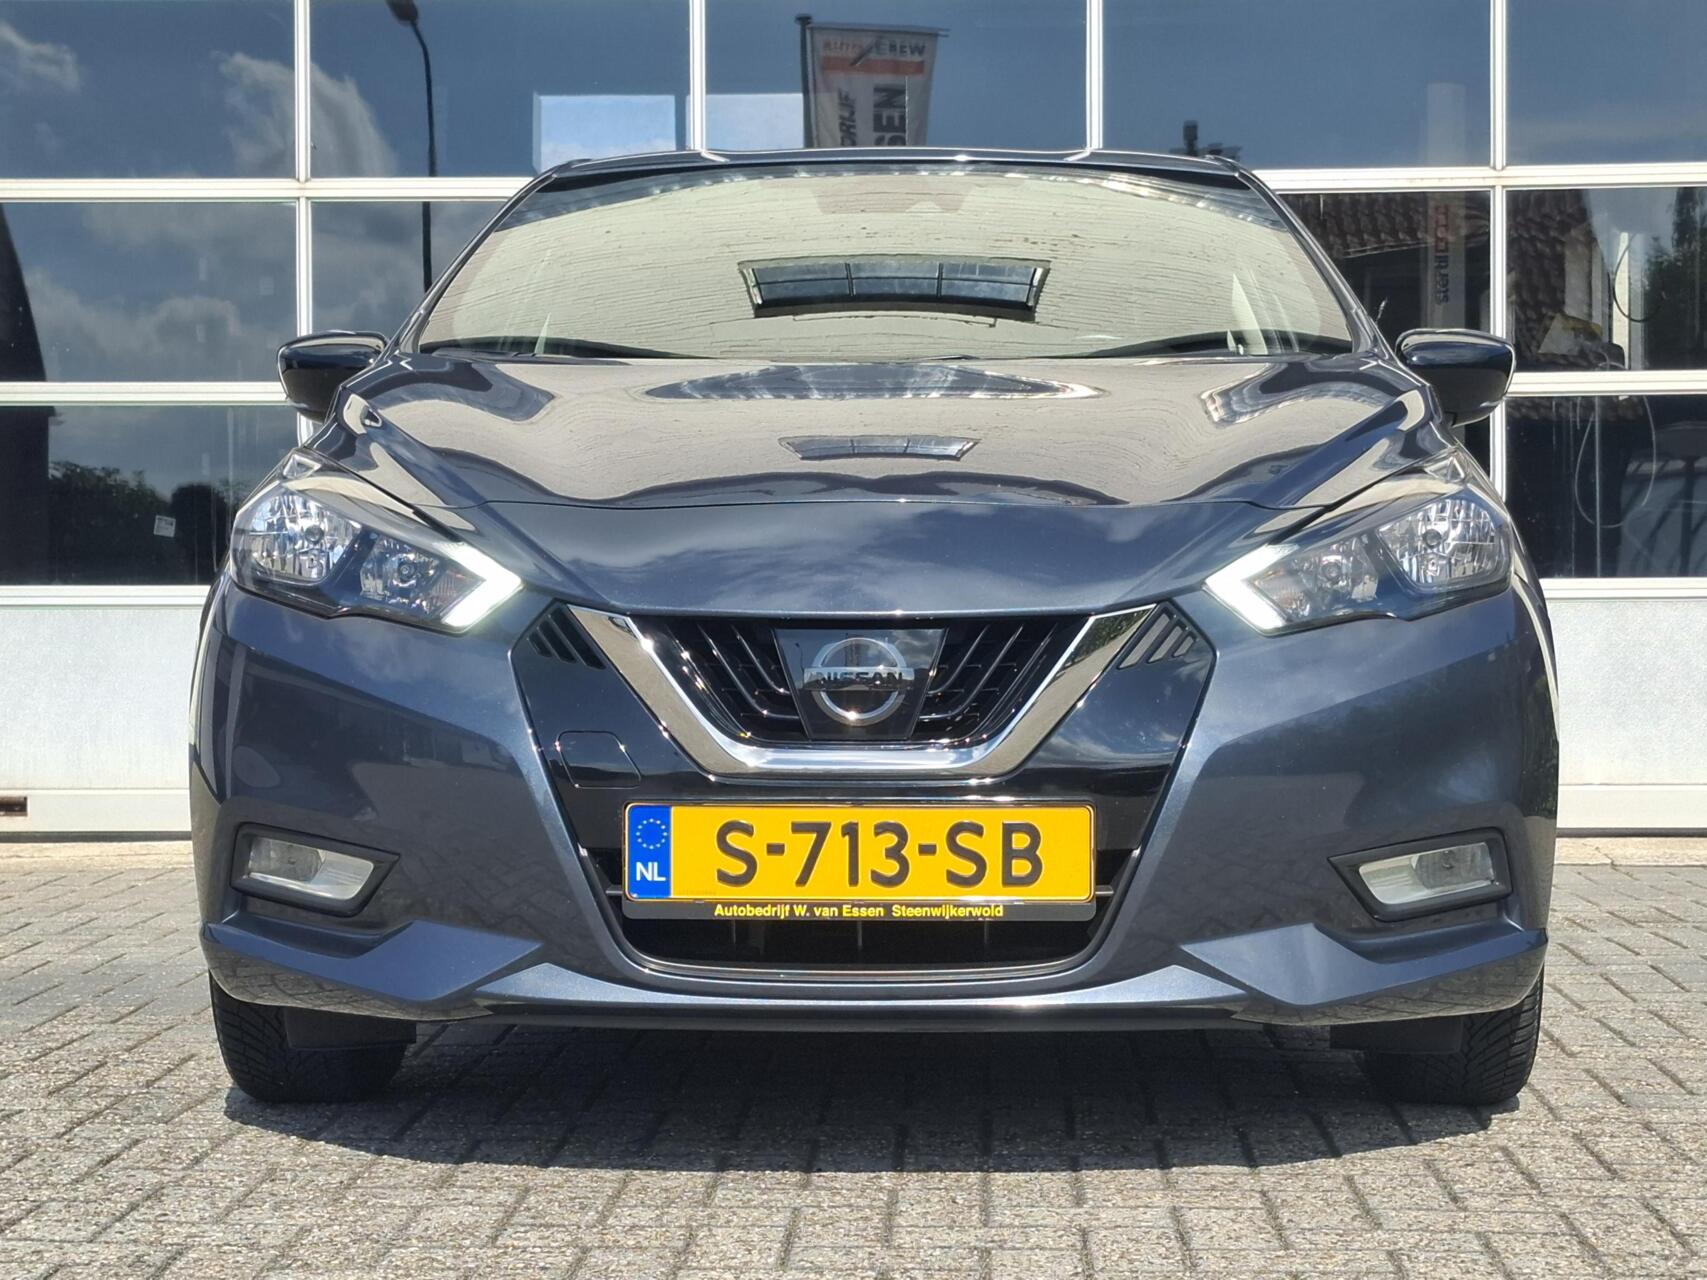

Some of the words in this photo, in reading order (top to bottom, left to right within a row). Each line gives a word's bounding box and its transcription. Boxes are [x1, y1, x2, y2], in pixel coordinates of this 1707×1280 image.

[811, 671, 903, 686] NISSAN
[715, 820, 1044, 888] S-713-SB
[636, 861, 666, 882] NL
[714, 904, 791, 920] Autobedrijf
[793, 904, 810, 918] W.
[814, 907, 839, 918] van
[842, 904, 885, 918] Essen
[892, 904, 1004, 920] Steenwijkerwold
